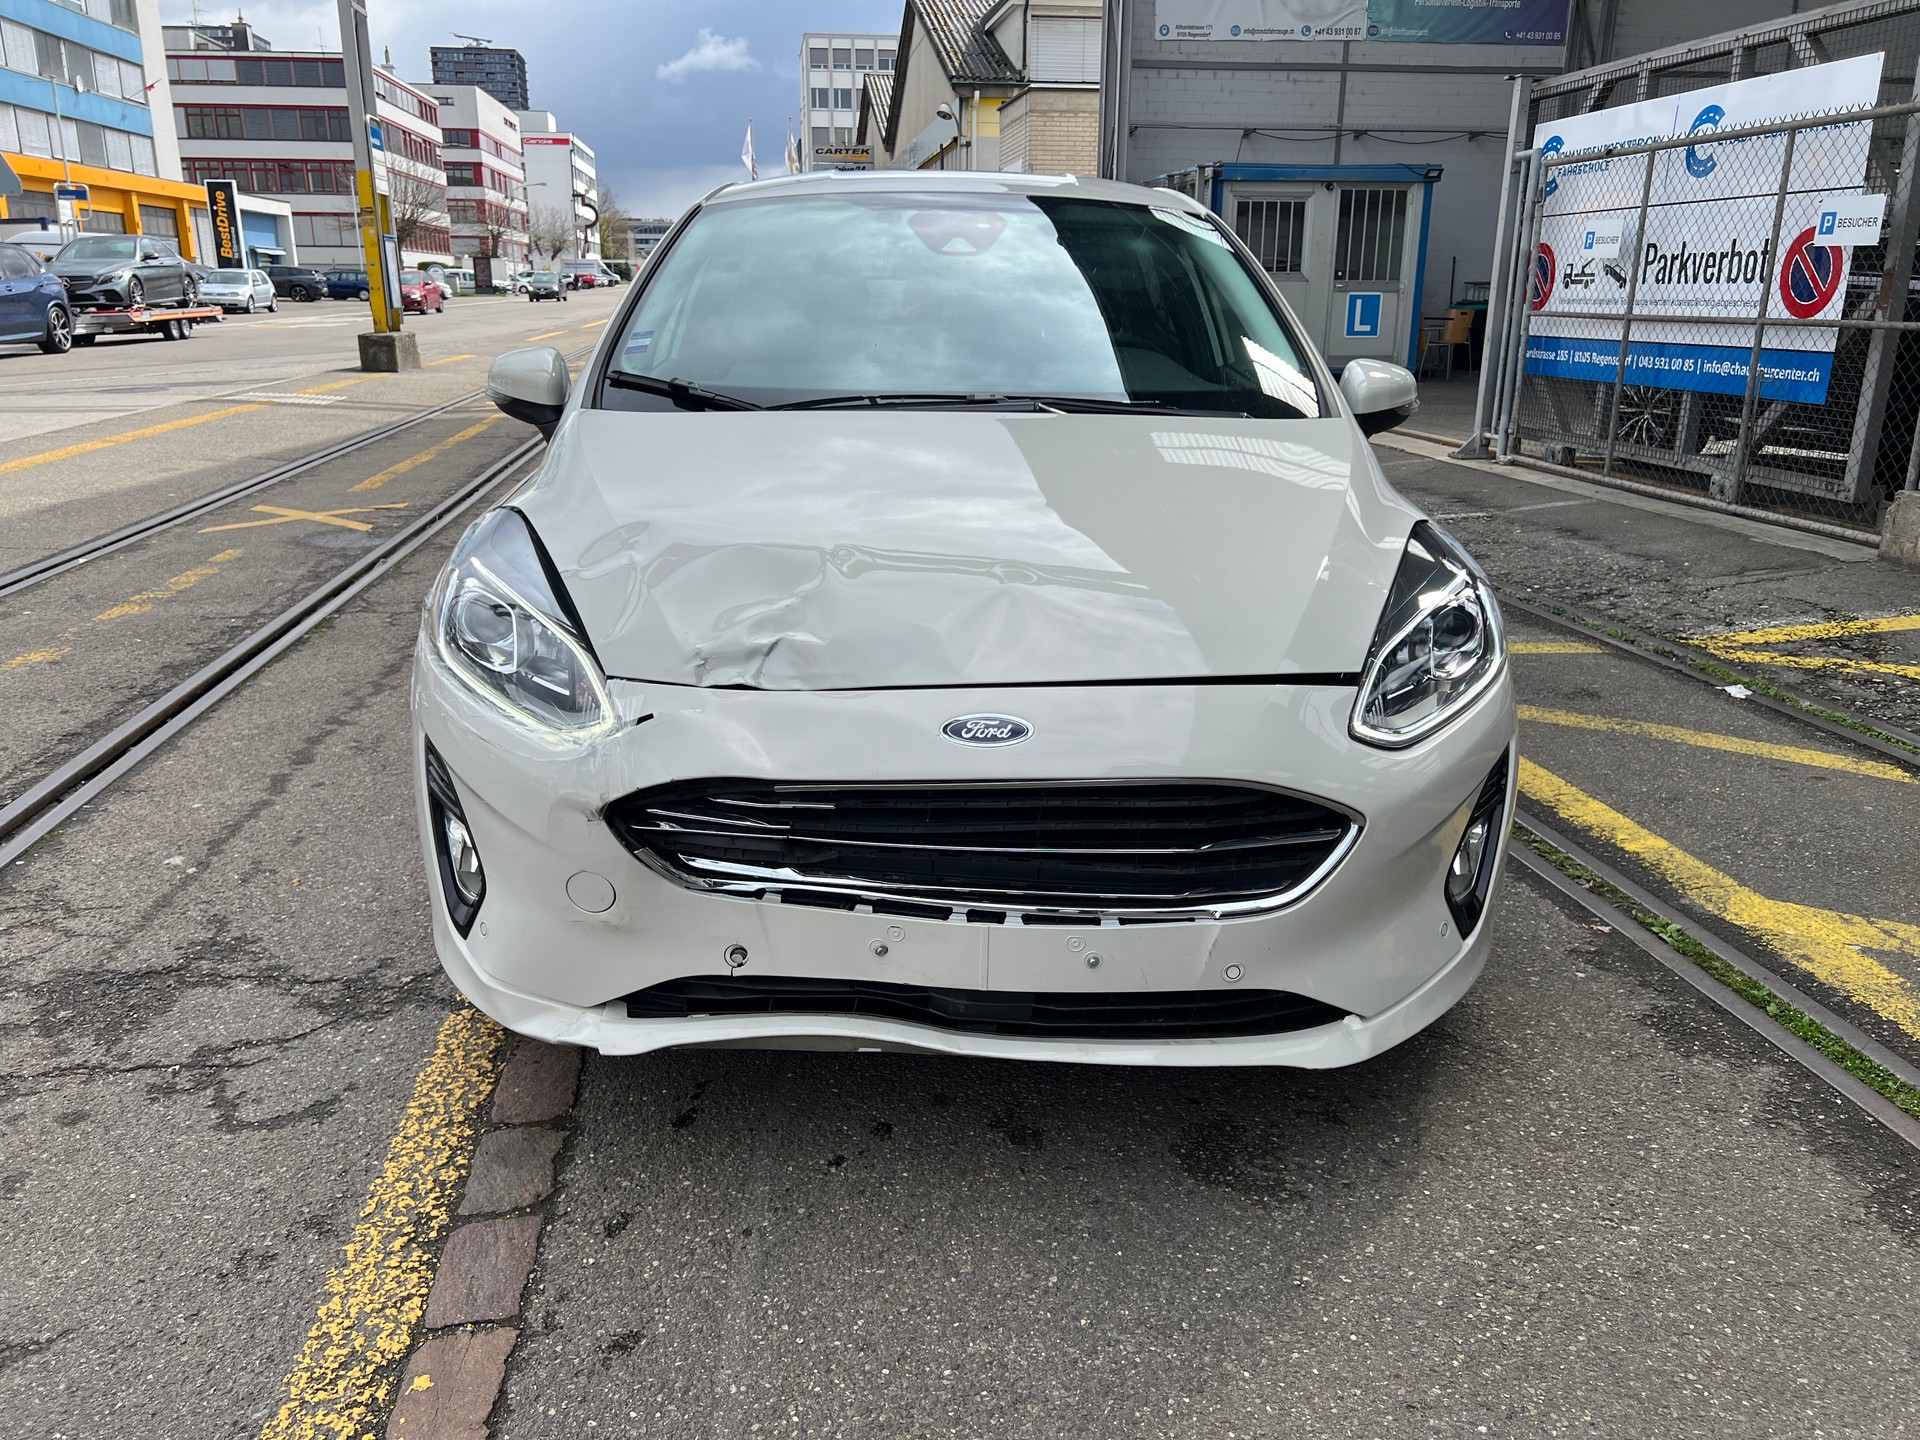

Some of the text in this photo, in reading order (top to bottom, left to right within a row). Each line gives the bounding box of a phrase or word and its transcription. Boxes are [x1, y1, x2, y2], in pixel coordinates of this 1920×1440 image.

[213, 190, 233, 259] BestDrive
[1838, 217, 1878, 228] BESUCHER
[1595, 235, 1619, 245] BESUCHER
[1641, 238, 1770, 285] Parkverbot
[1353, 298, 1372, 332] L
[1525, 348, 1556, 360] ardstrasse
[1638, 355, 1653, 369] 043
[1654, 357, 1669, 370] 931
[1671, 358, 1682, 370] 00
[1683, 359, 1694, 372] 85
[961, 720, 1012, 739] Ford
